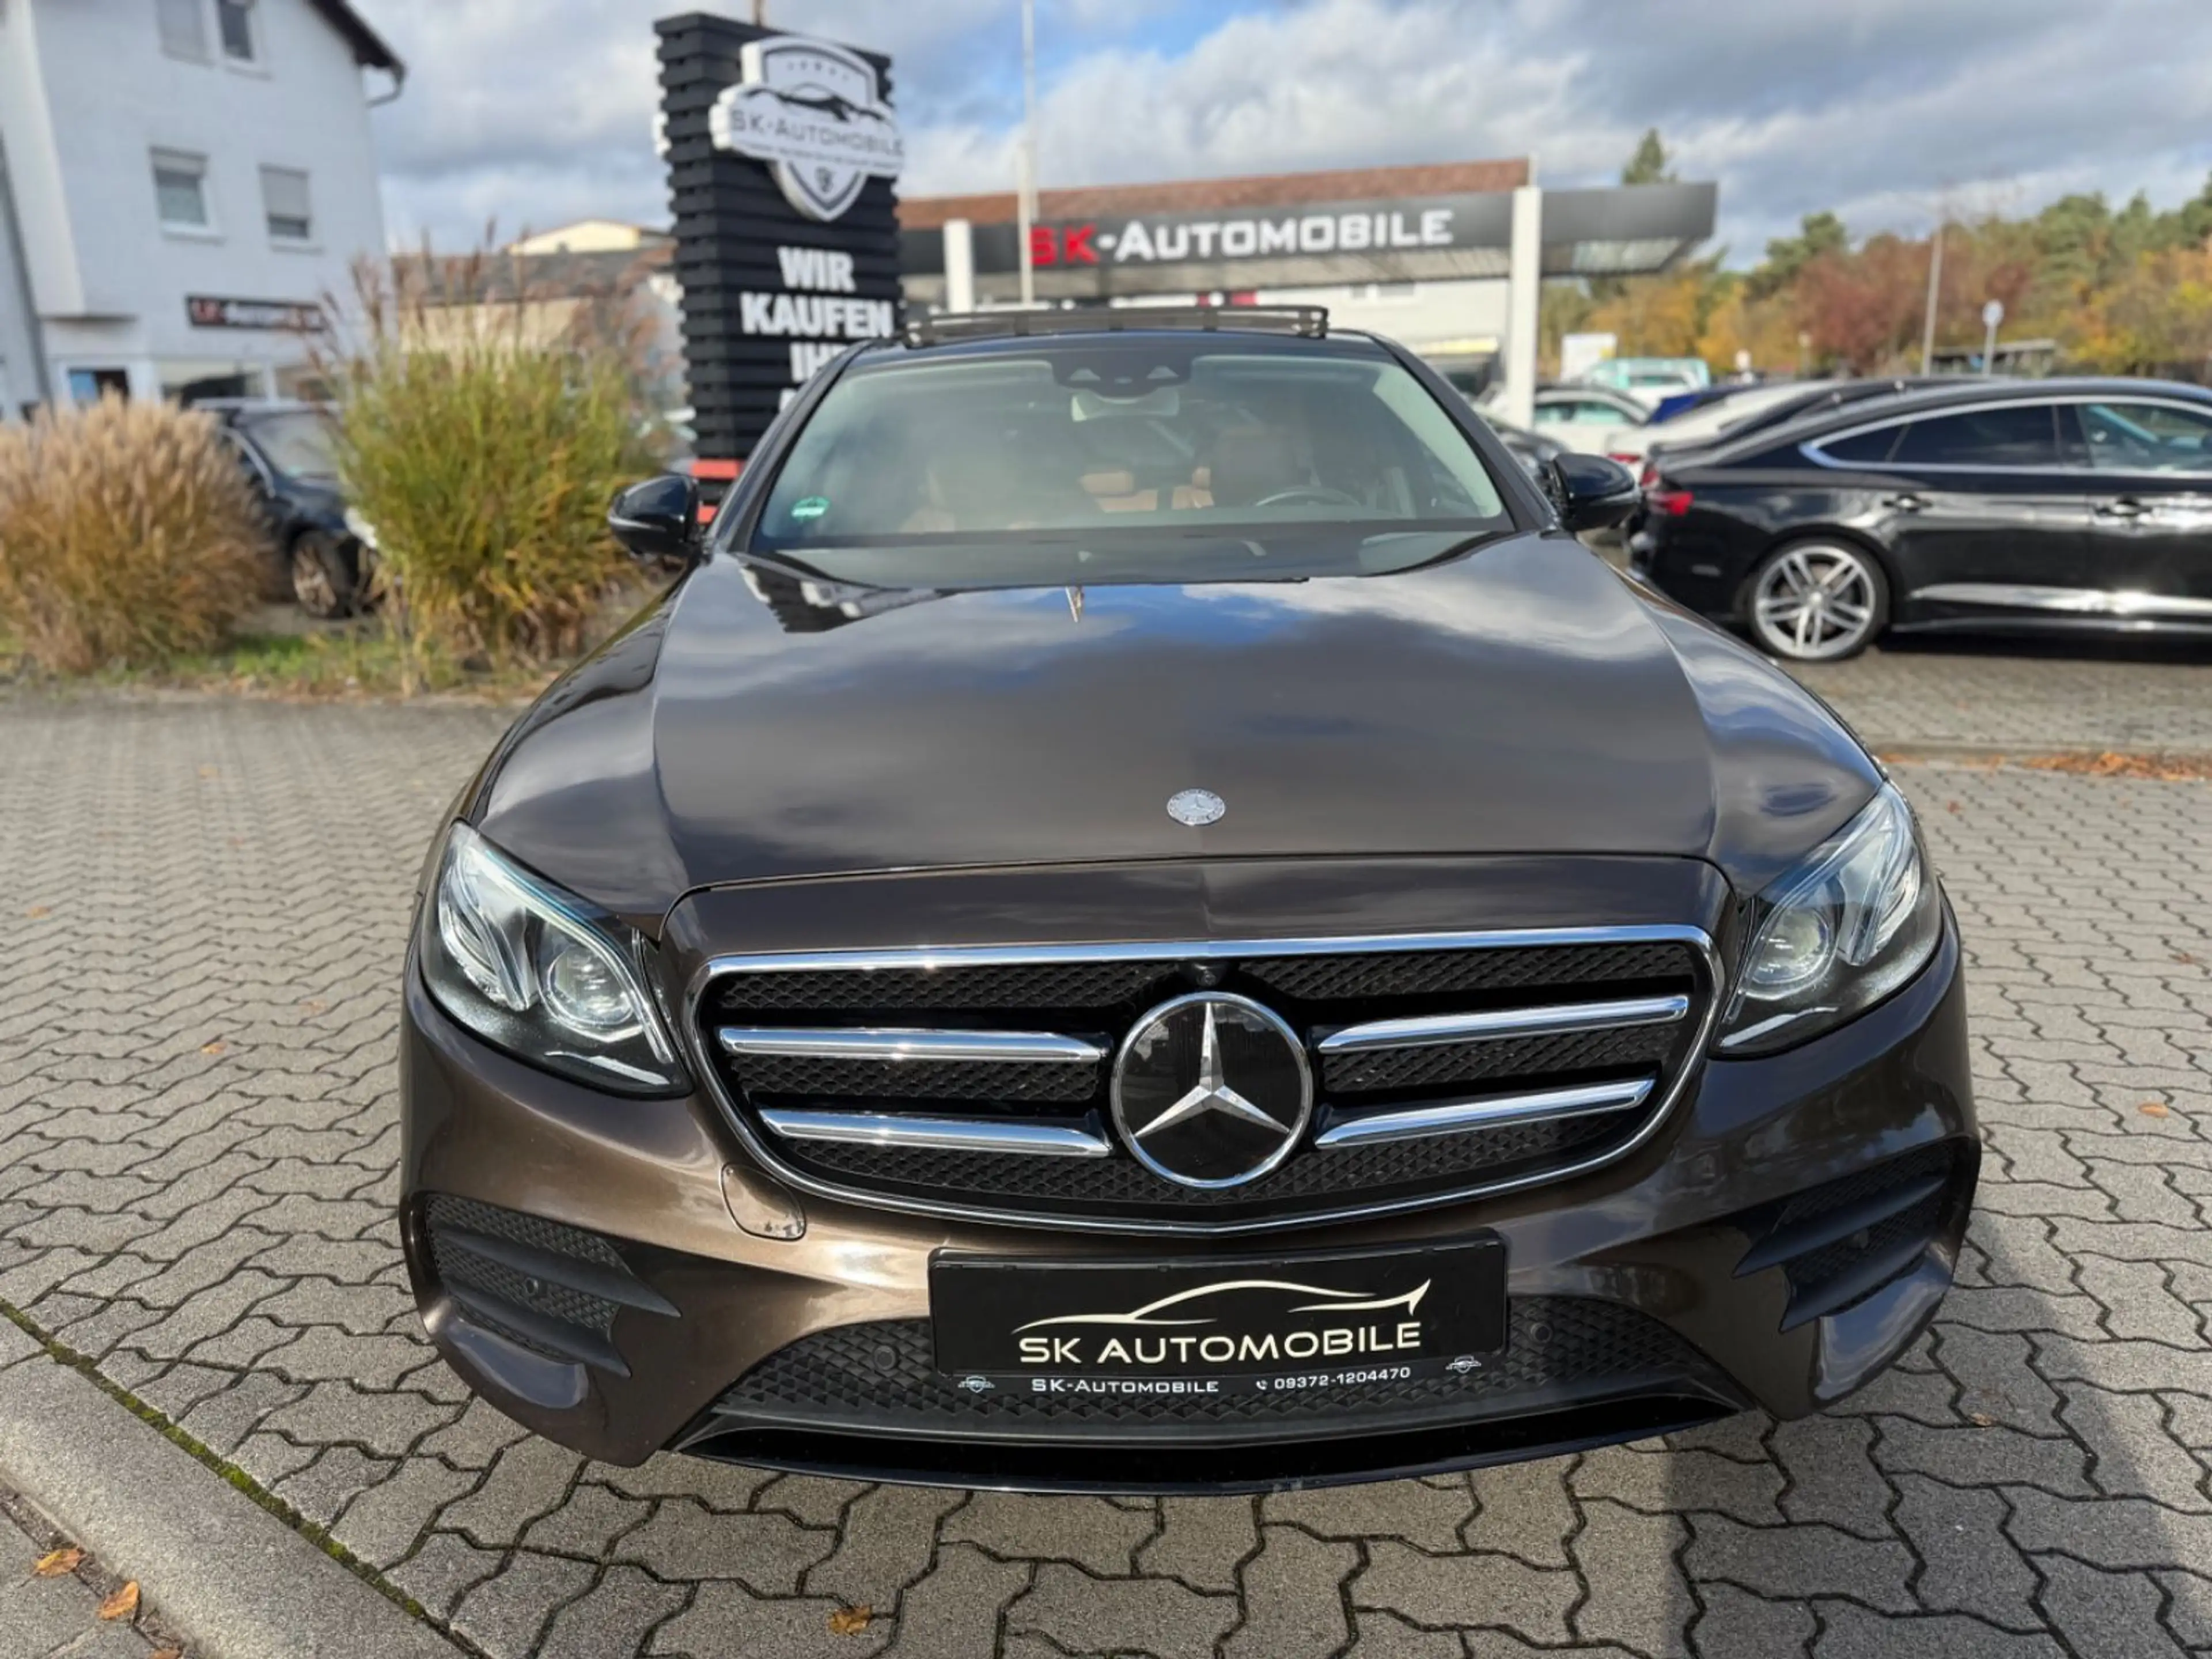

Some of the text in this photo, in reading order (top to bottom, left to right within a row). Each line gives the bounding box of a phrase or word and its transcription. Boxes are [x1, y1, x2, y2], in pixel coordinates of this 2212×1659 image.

[776, 246, 857, 293] WIR
[740, 292, 895, 338] KAUFEN
[1018, 1322, 1422, 1364] SK AUTOMOBILE
[1274, 1366, 1411, 1390] 09372-1204470
